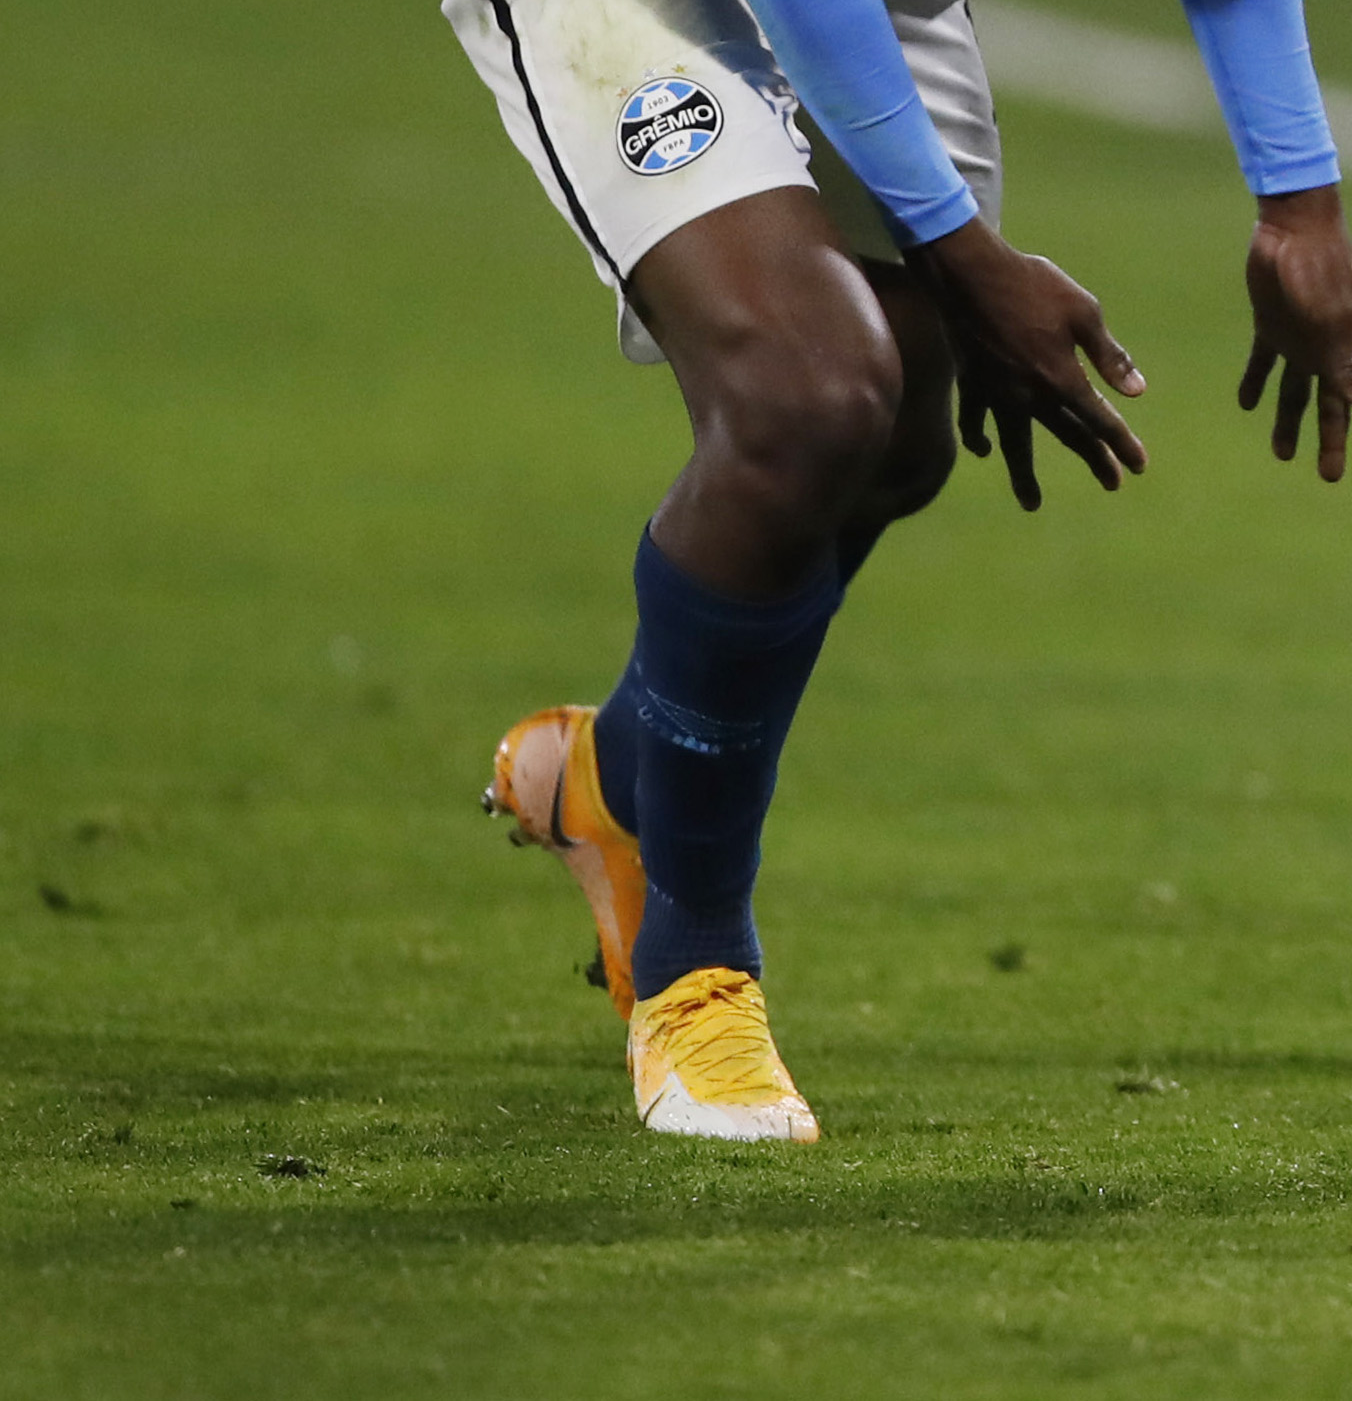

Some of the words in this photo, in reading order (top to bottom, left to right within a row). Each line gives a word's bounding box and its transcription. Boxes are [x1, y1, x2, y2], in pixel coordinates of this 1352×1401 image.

[647, 95, 670, 110] 1903
[625, 104, 714, 156] GRÊMIO
[663, 138, 685, 153] FBPA
